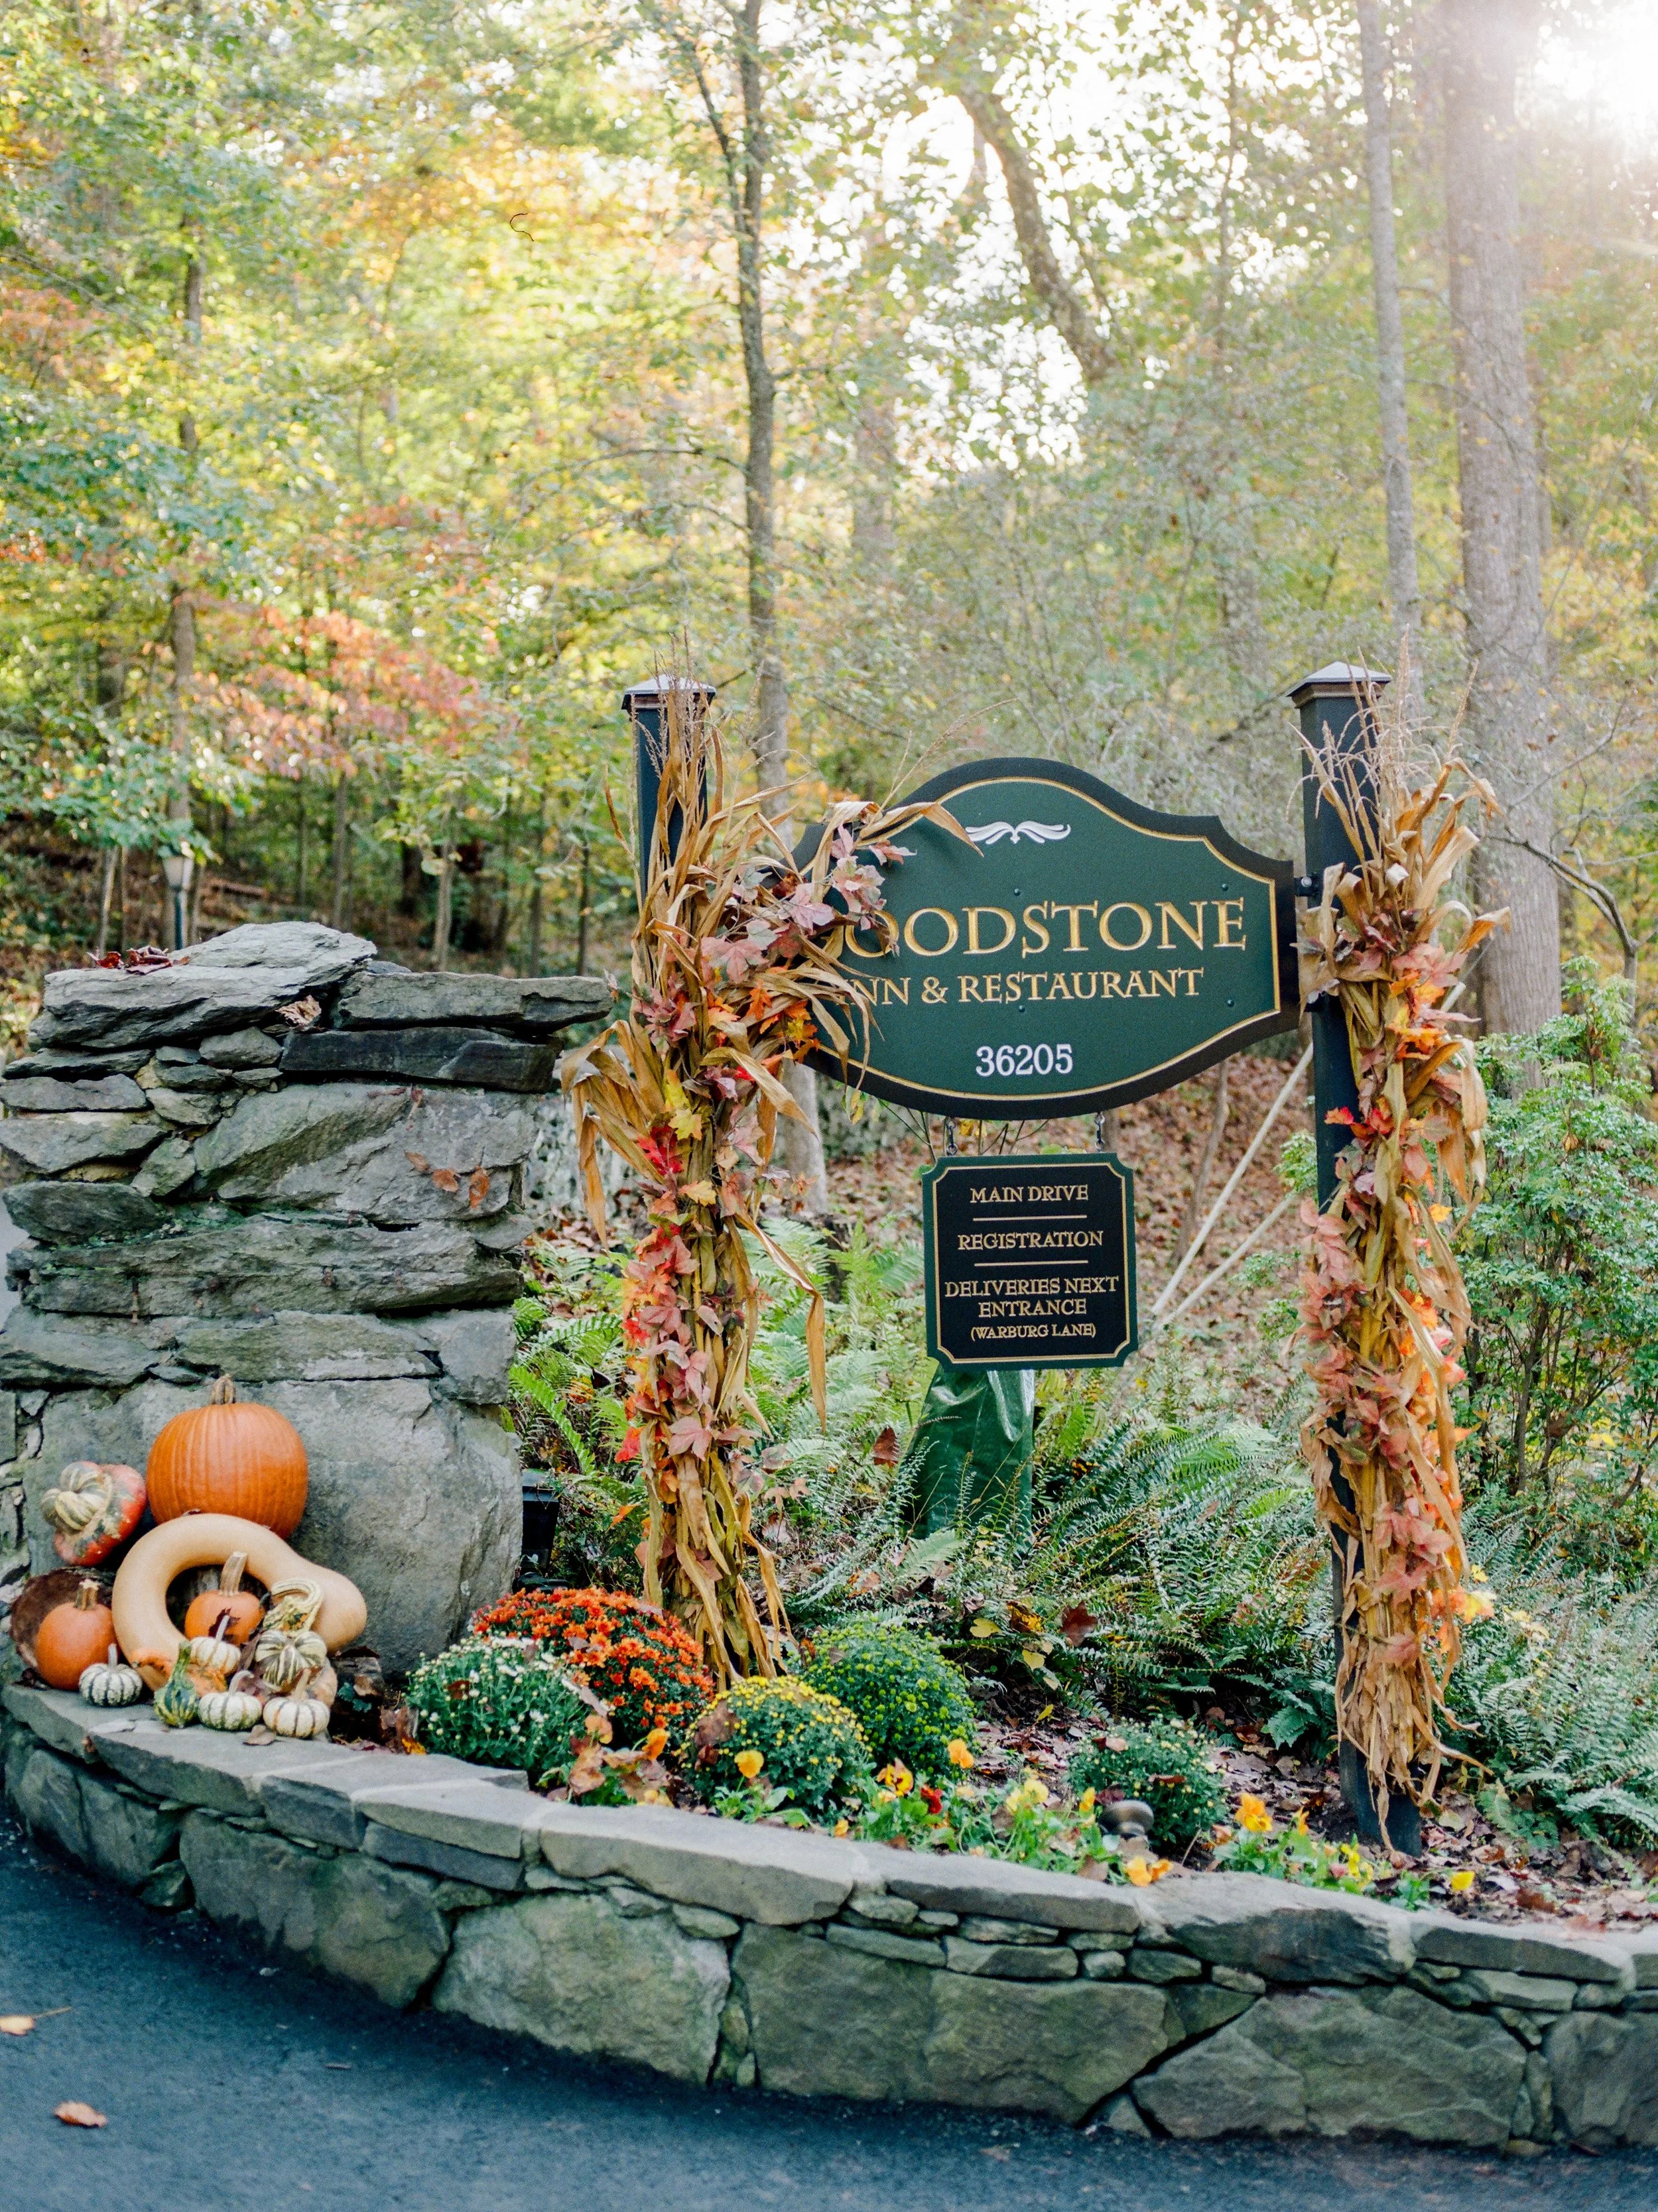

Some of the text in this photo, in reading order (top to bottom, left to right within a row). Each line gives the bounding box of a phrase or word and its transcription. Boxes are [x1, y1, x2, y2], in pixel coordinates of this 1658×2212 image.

[844, 897, 1247, 958] OODSTONE
[921, 976, 948, 1004] &
[958, 967, 1204, 1004] RESTAURANT
[976, 1044, 1074, 1077] 36205
[970, 1184, 1088, 1203] MAIN DRIVE
[957, 1231, 1103, 1251] REGISTRATION
[944, 1276, 1119, 1298] DELIVERIES NEXT
[978, 1298, 1087, 1318] ENTRANCE
[970, 1323, 1096, 1341] (WARBURG LANE)
